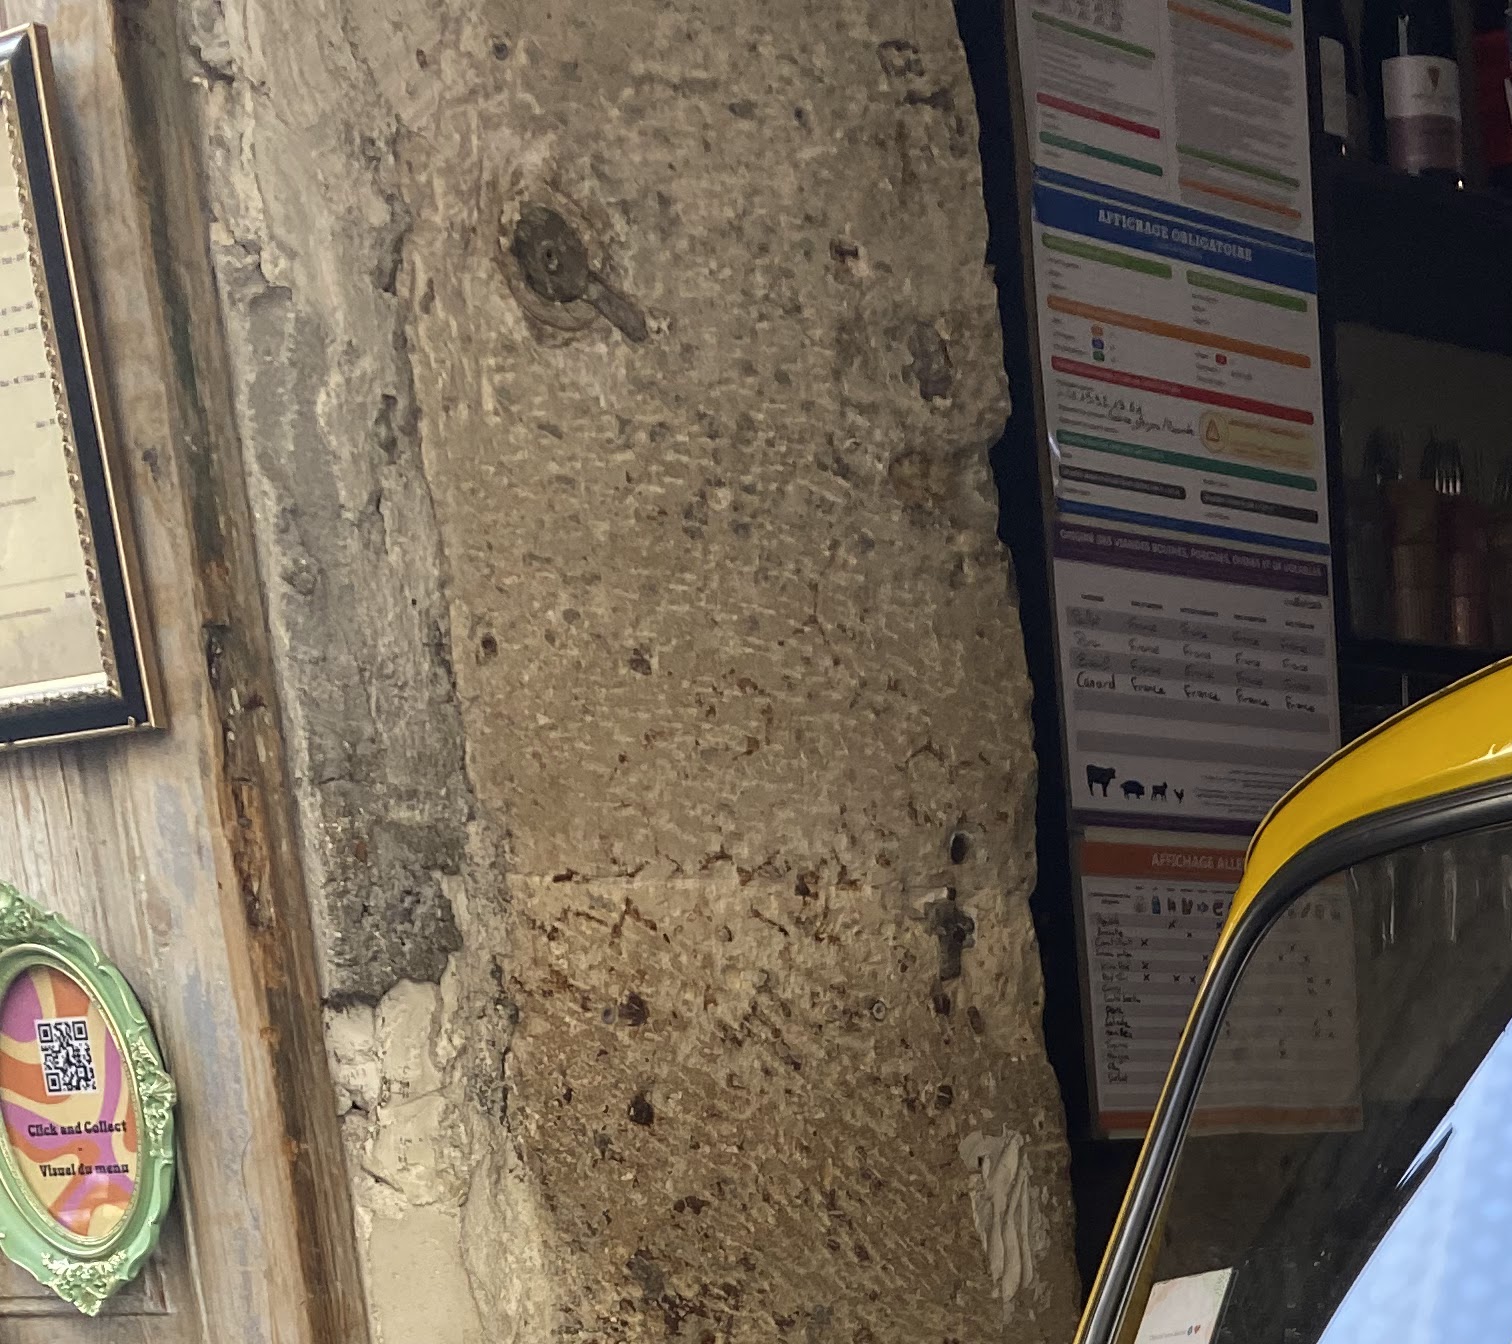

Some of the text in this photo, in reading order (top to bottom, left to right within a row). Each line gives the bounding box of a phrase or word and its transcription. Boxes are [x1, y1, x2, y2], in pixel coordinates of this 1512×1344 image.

[1151, 852, 1215, 870] AFFICHAGE
[28, 1120, 127, 1137] Click and Collect
[39, 1162, 129, 1177] Visual du menu
